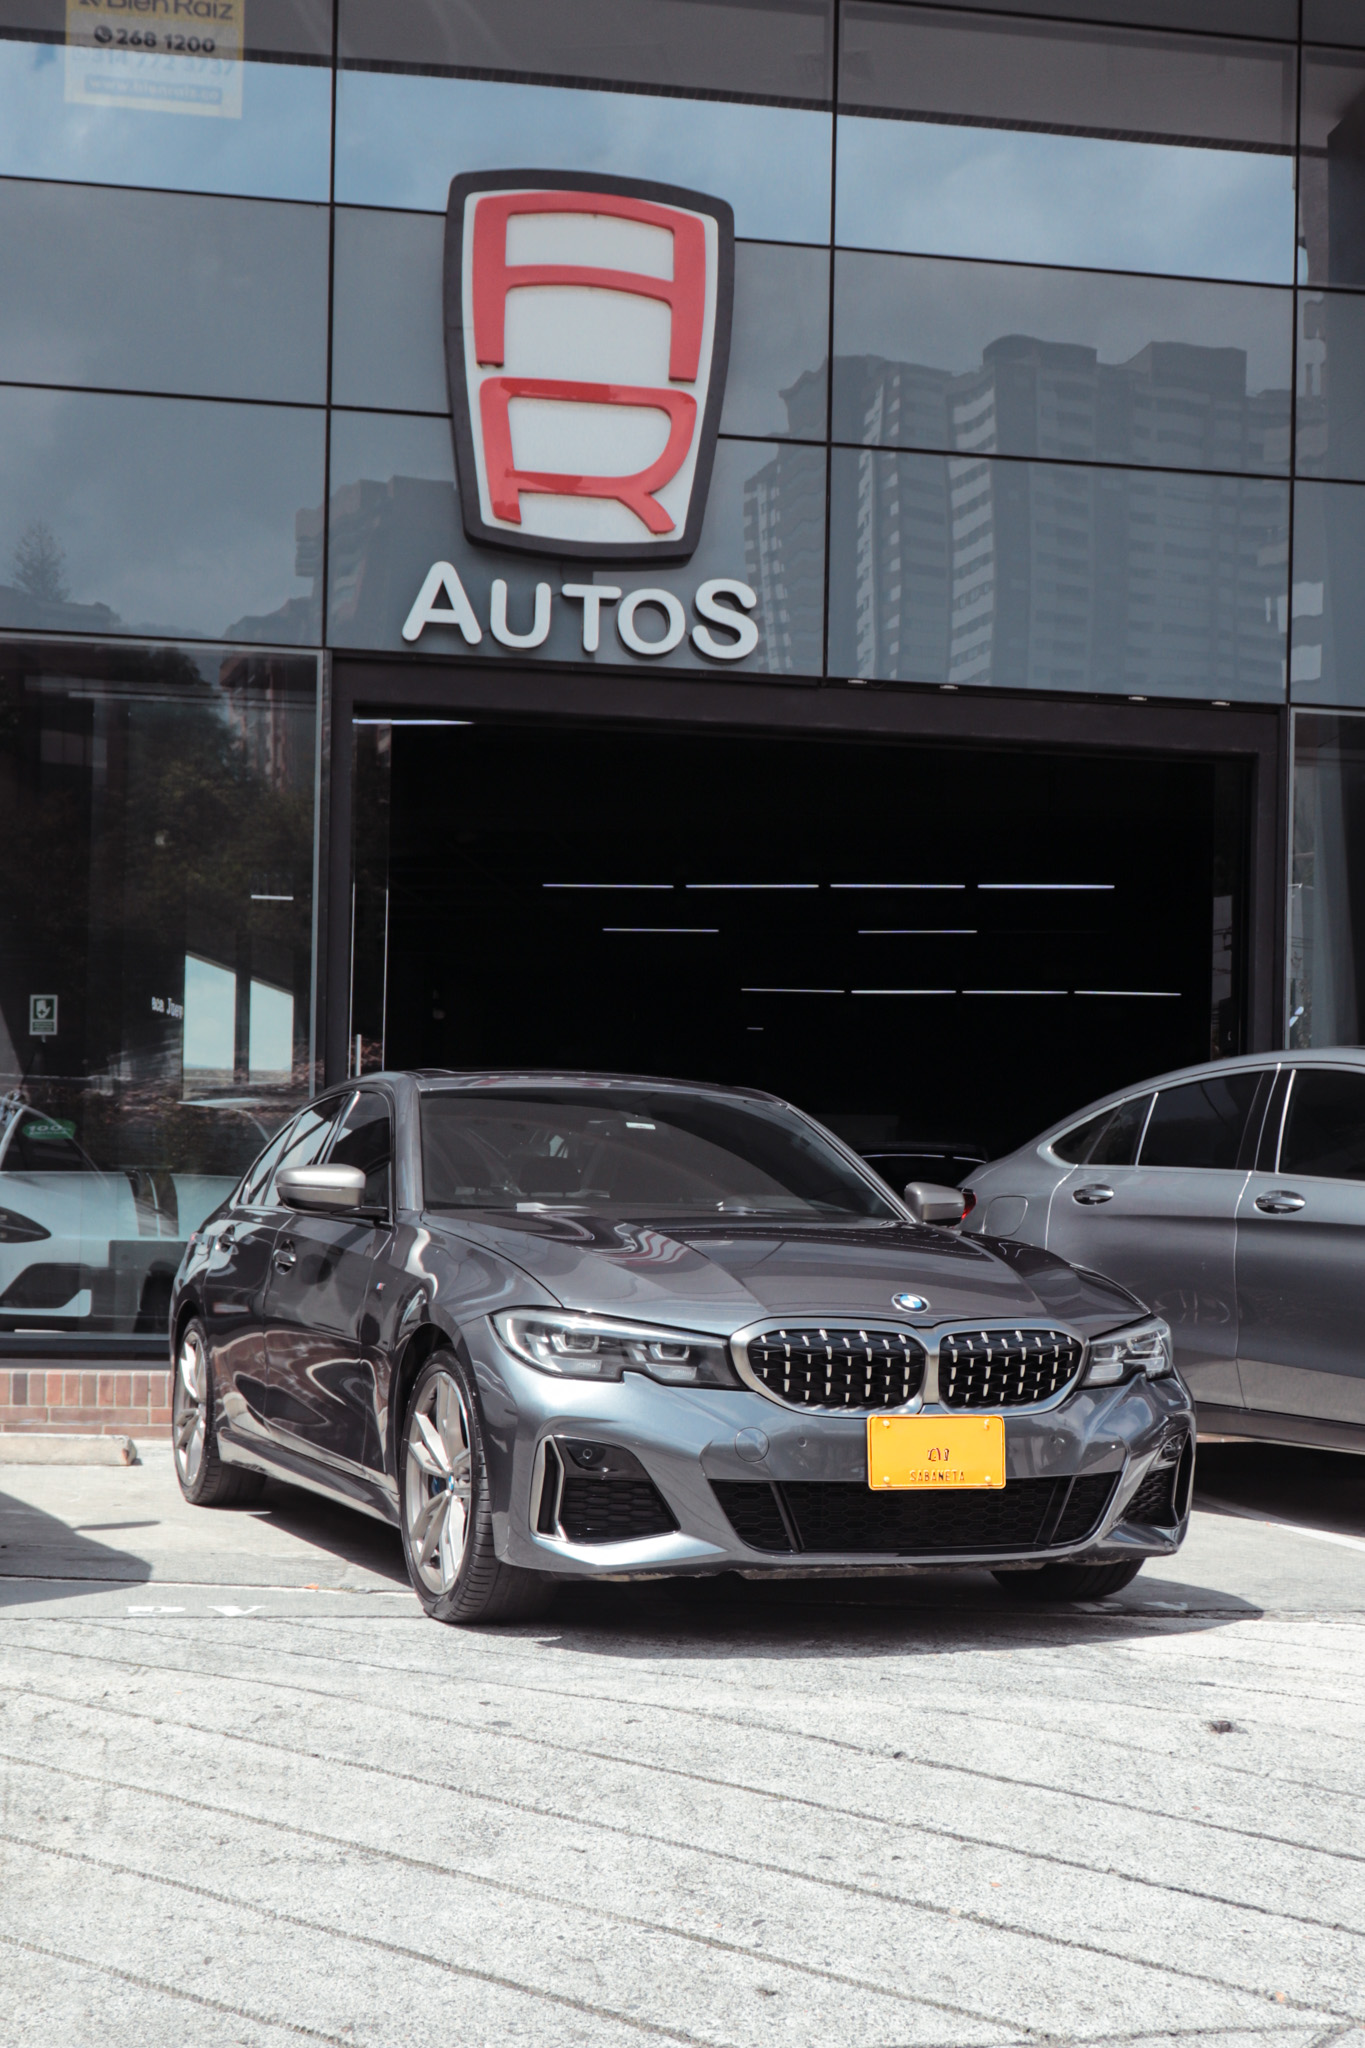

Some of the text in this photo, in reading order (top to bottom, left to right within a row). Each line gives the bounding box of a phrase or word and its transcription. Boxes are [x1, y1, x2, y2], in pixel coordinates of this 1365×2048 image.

[116, 27, 216, 53] 268 1200
[909, 1469, 966, 1482] SABANETA
